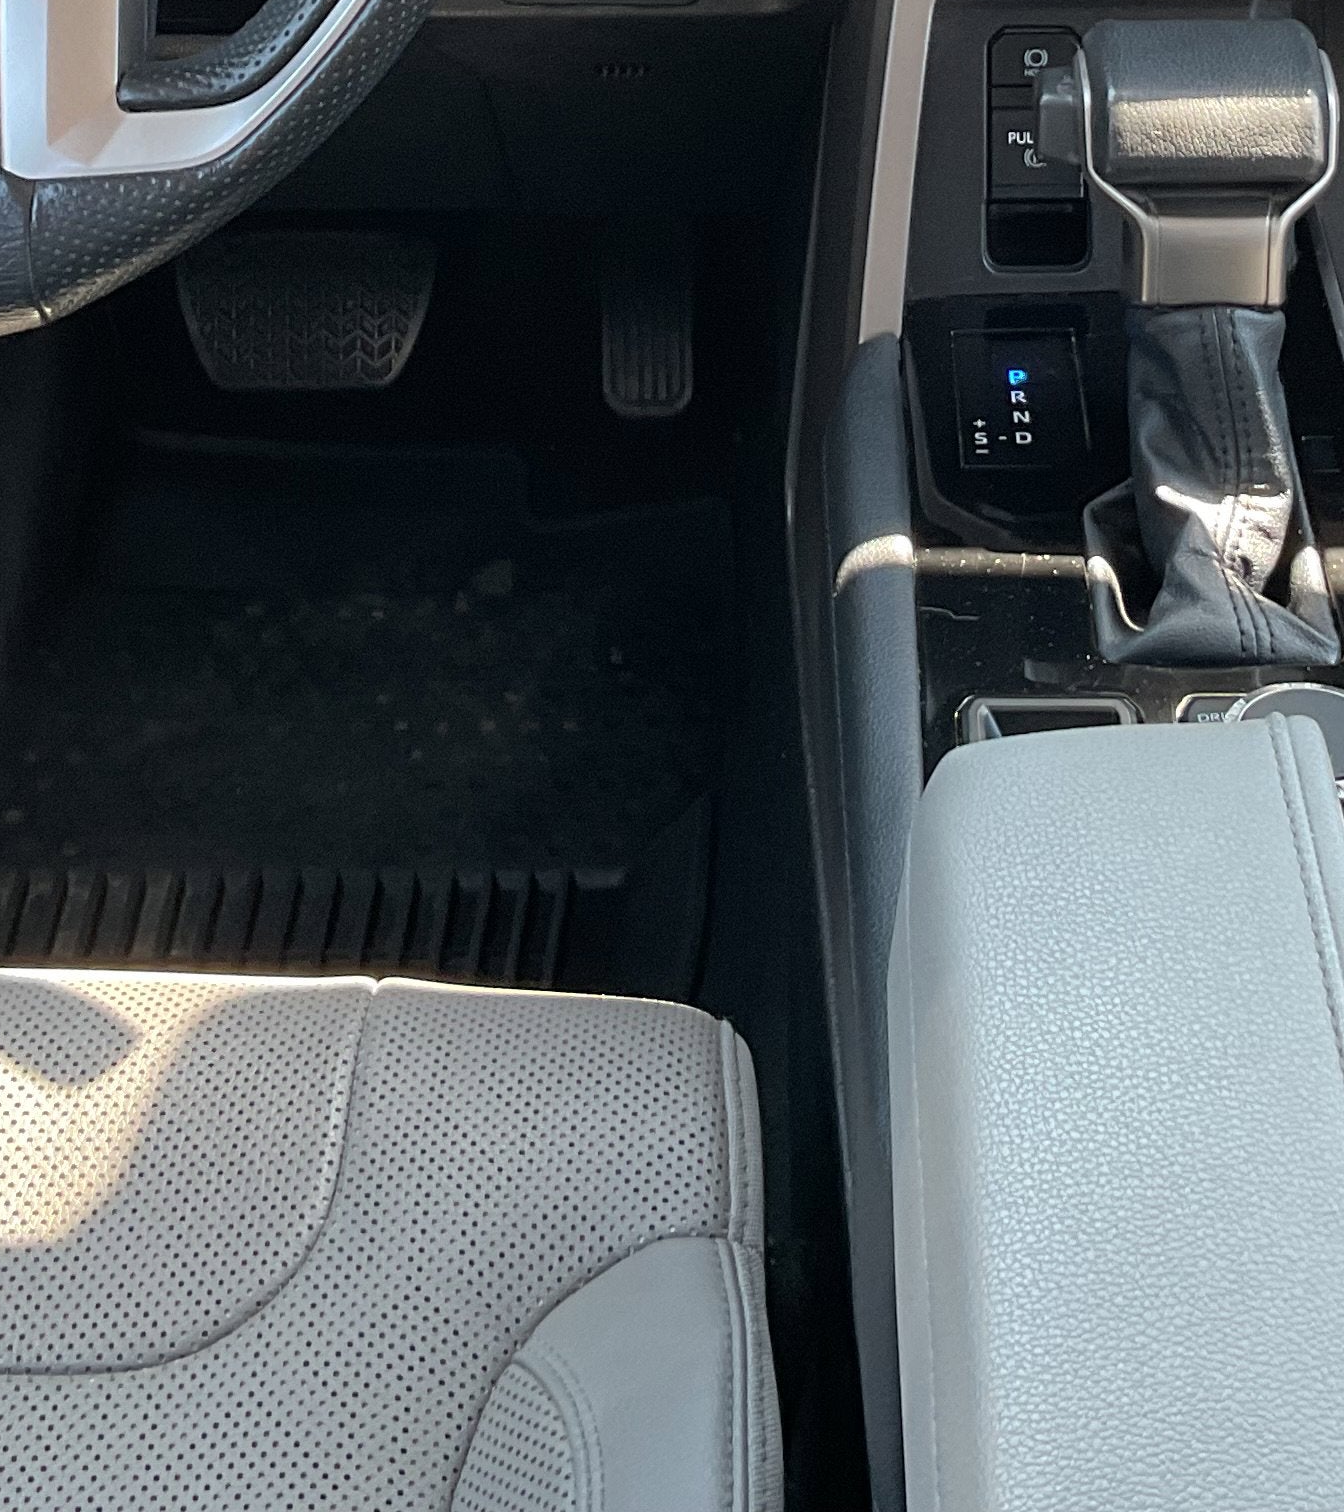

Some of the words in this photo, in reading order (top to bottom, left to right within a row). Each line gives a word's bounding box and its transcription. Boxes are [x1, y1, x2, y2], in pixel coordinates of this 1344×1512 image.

[1008, 131, 1034, 145] PUL
[1008, 369, 1028, 386] P
[1010, 390, 1027, 404] R
[1012, 410, 1030, 424] N
[974, 432, 988, 445] S
[1015, 431, 1033, 444] D
